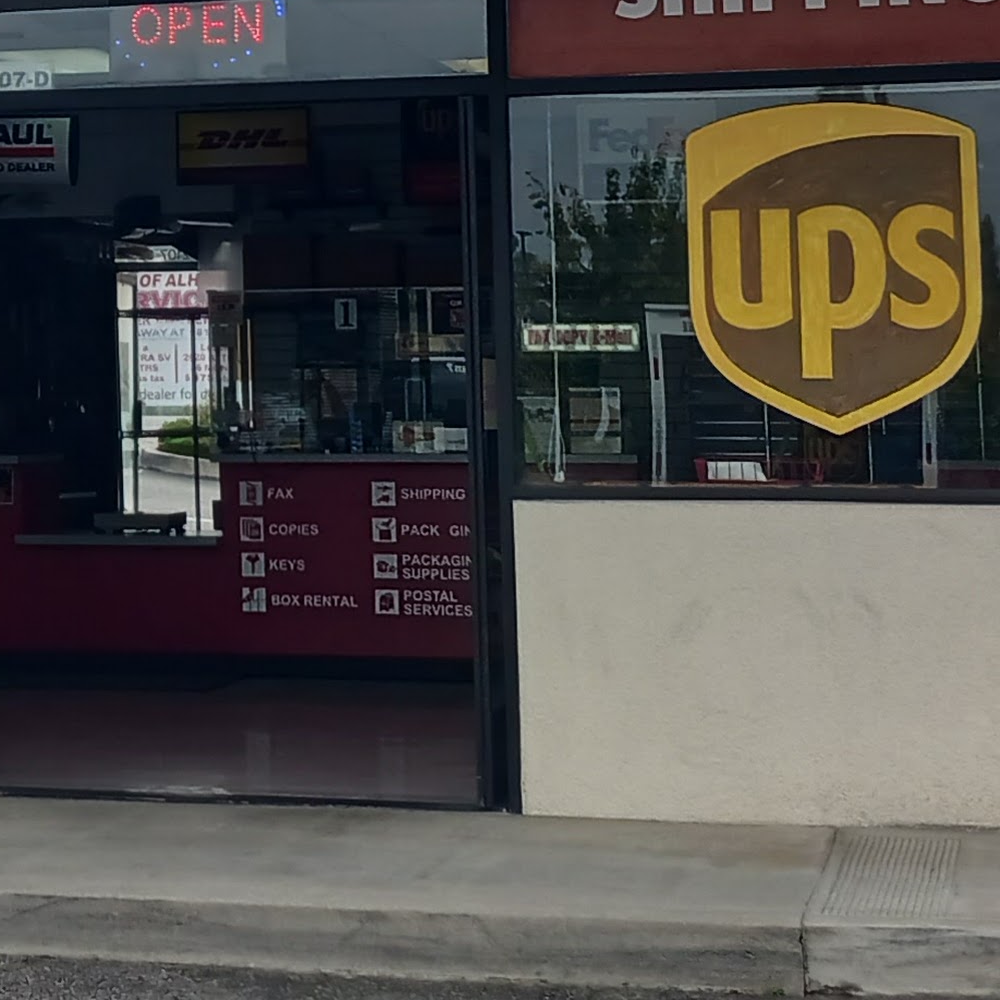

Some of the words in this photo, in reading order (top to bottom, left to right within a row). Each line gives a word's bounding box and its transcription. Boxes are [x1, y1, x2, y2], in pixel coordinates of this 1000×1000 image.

[131, 3, 264, 44] OPEN
[197, 127, 289, 150] DHL
[8, 162, 55, 173] DEALER
[139, 273, 162, 288] OF
[710, 203, 961, 380] ups
[267, 488, 294, 499] FAX
[400, 489, 466, 501] SHIPPING
[268, 523, 320, 536] COPIES
[400, 525, 440, 537] PACK
[268, 559, 306, 571] KEYS
[401, 567, 471, 580] SUPPLIES
[271, 594, 301, 607] BOX
[304, 595, 359, 608] RENTAL
[403, 590, 459, 602] POSTAL
[403, 603, 473, 617] SERVICES
